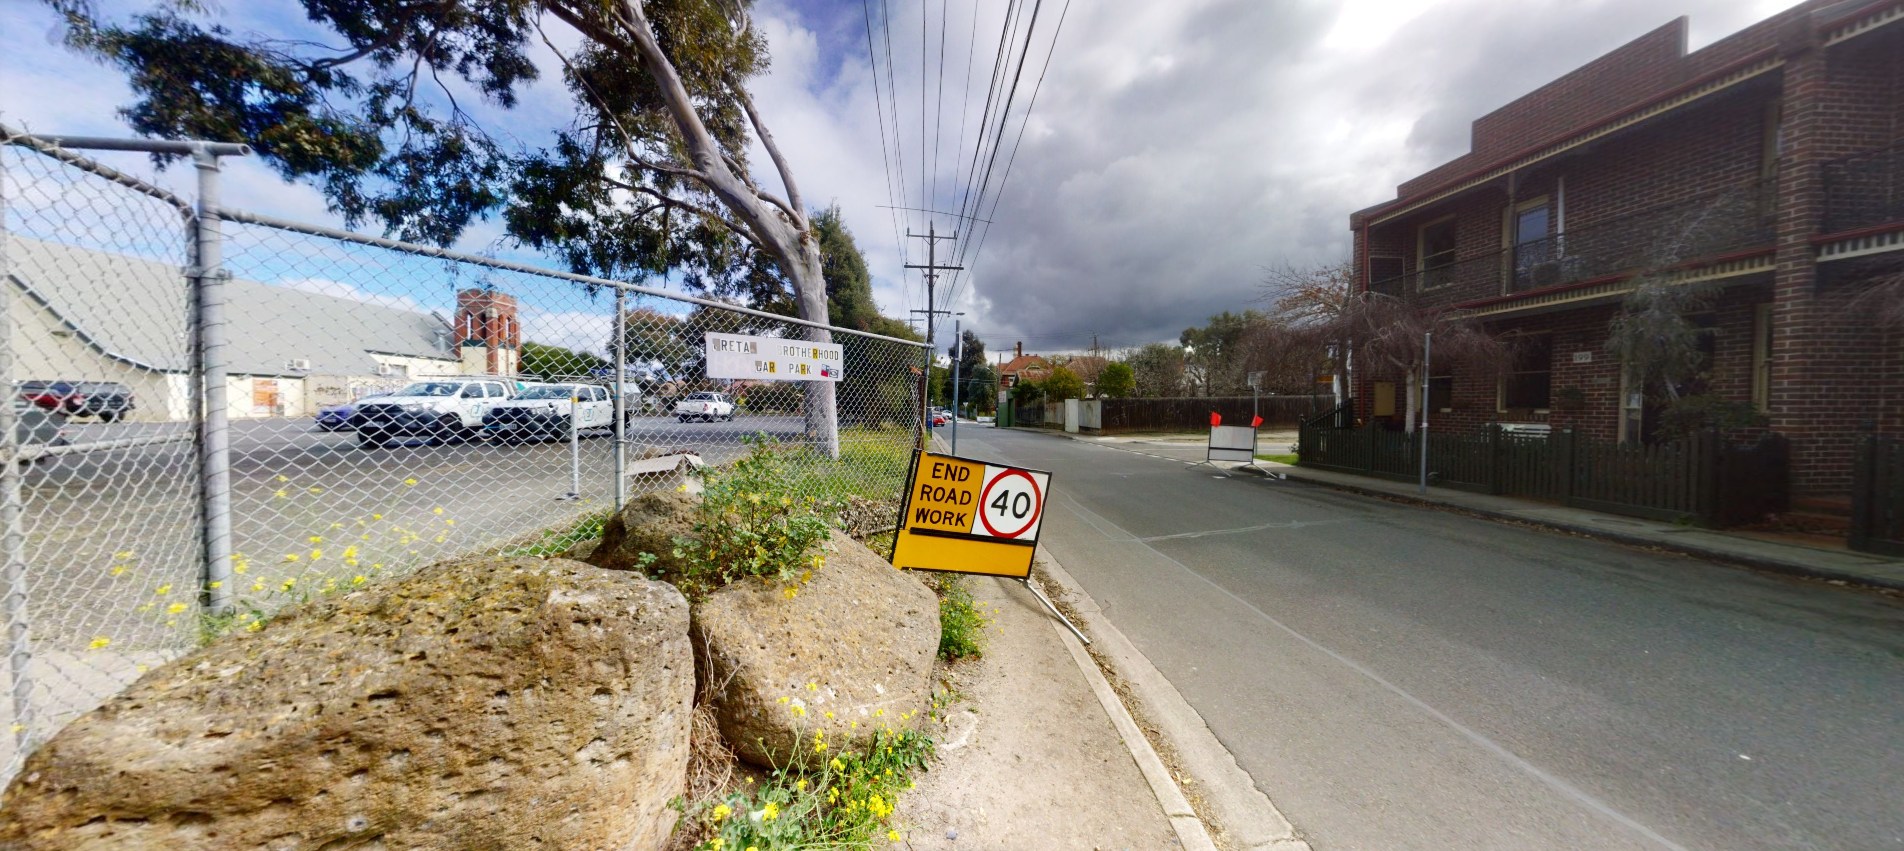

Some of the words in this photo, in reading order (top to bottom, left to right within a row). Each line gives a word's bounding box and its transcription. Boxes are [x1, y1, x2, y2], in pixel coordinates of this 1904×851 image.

[713, 339, 756, 353] RETA
[789, 363, 812, 374] PARK
[932, 462, 970, 482] END
[920, 484, 972, 505] ROAD
[991, 489, 1031, 519] 40
[915, 508, 968, 527] WORK
